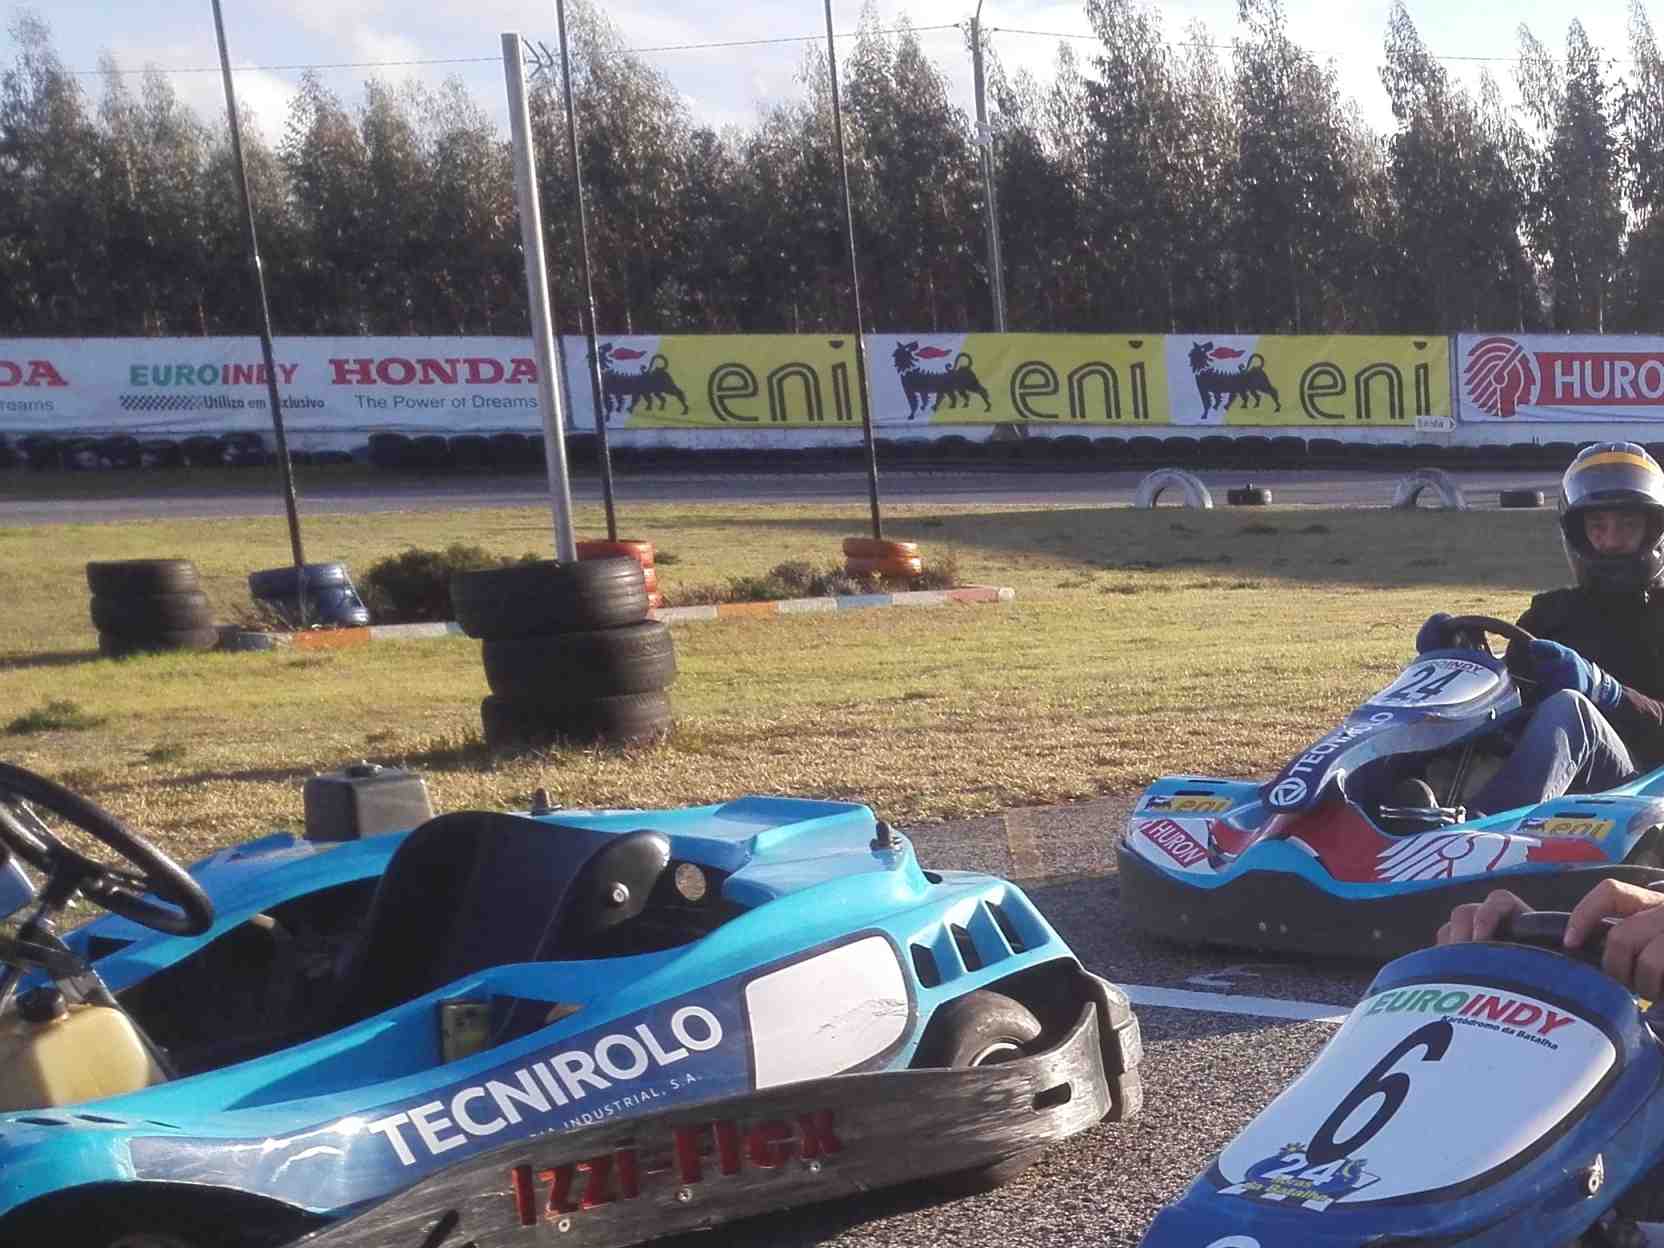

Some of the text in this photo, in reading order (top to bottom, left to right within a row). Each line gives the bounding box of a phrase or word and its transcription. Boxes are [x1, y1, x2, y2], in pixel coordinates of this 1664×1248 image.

[329, 357, 539, 386] HONDA
[707, 339, 853, 422] eni
[1010, 339, 1150, 420] eni
[1300, 341, 1431, 420] eni
[355, 394, 538, 409] The Power of Dreams
[1385, 664, 1463, 702] 24
[1149, 820, 1206, 863] HURON
[1364, 988, 1577, 1037] EUROINDY
[1516, 1030, 1559, 1052] Batalha
[370, 1004, 723, 1168] TECNIROLO
[1305, 1020, 1455, 1165] 6
[563, 1087, 667, 1129] INDUSTRIAL,
[1260, 1152, 1346, 1186] 24
